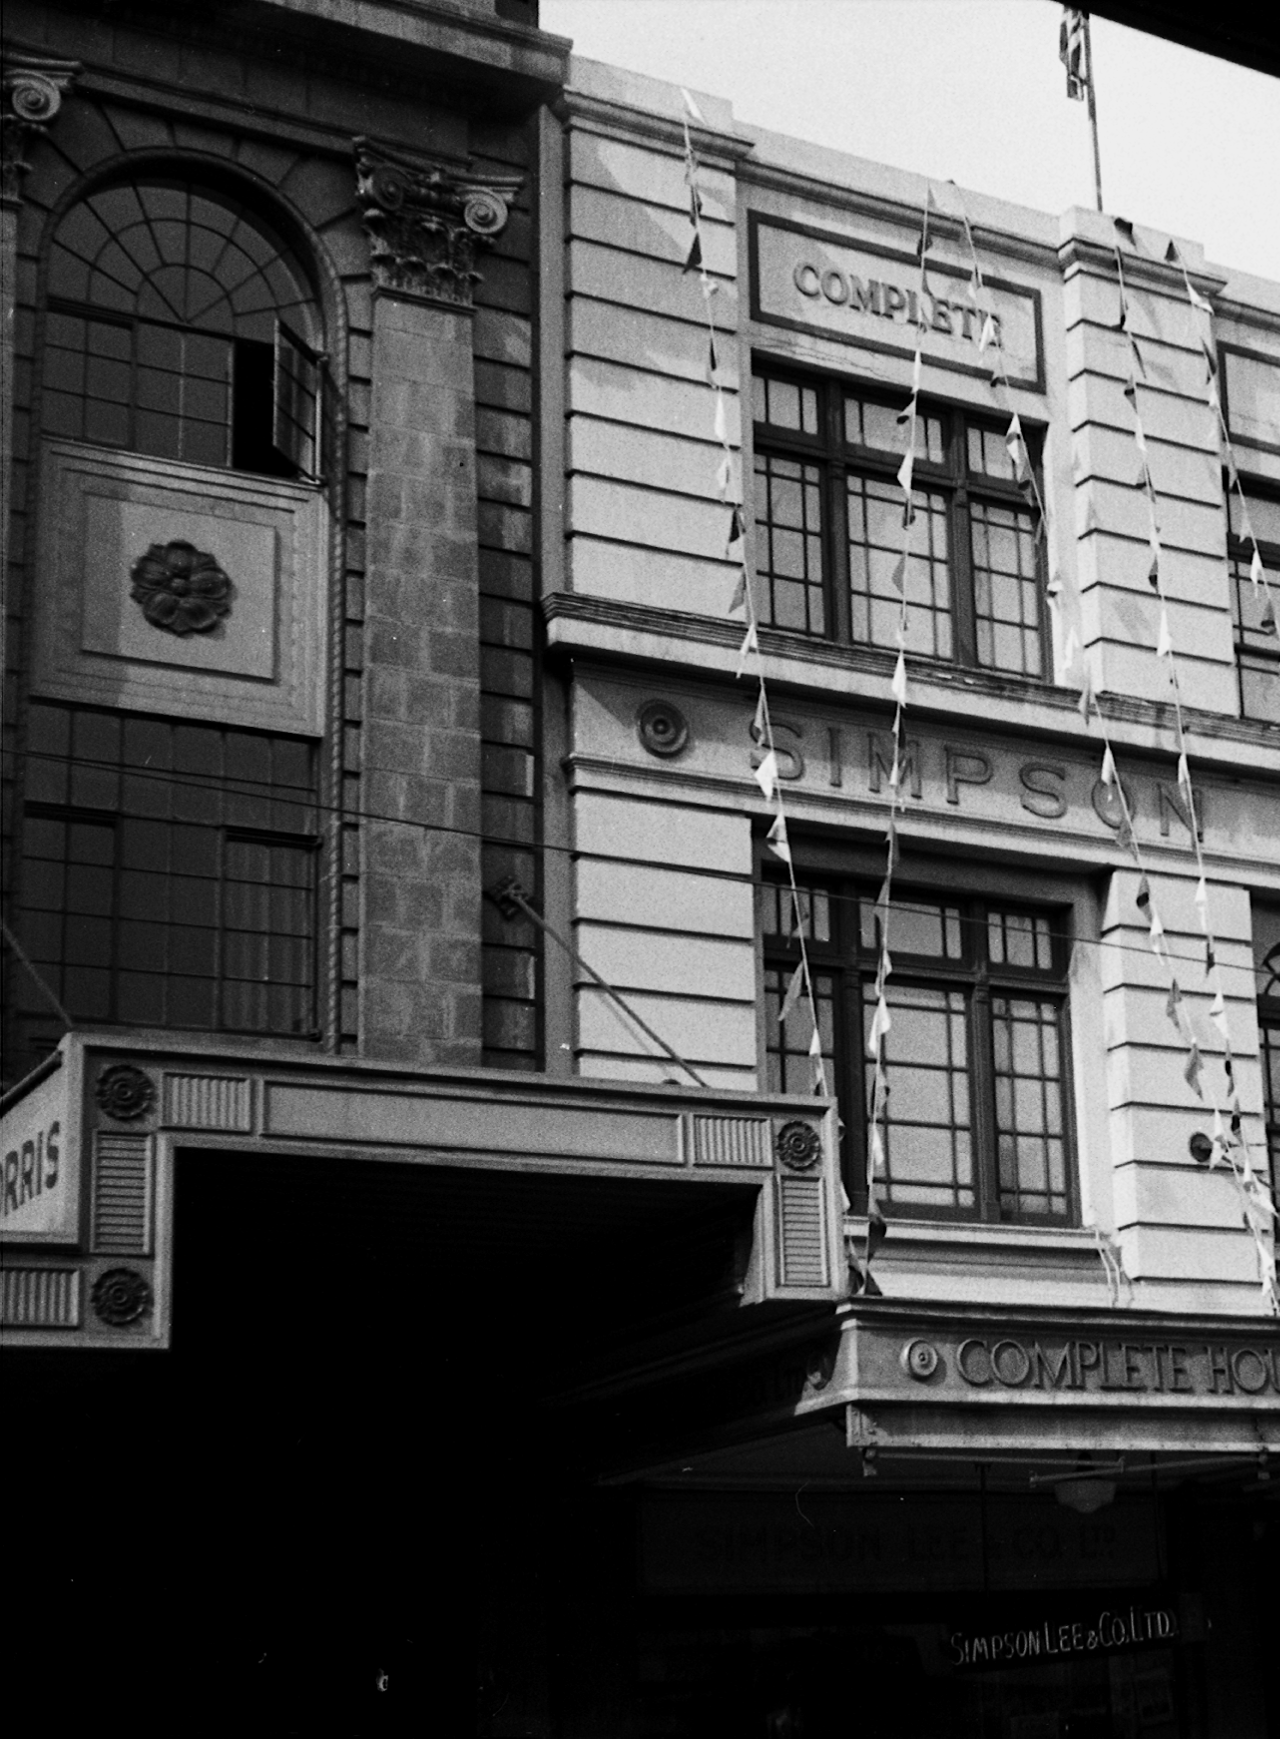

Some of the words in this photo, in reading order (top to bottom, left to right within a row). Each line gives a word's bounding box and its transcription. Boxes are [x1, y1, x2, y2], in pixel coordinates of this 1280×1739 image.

[748, 715, 1208, 844] SIMPSON
[957, 1337, 1195, 1393] COMPLETE
[950, 1631, 1041, 1666] SIMPSON
[1043, 1620, 1085, 1654] LEE
